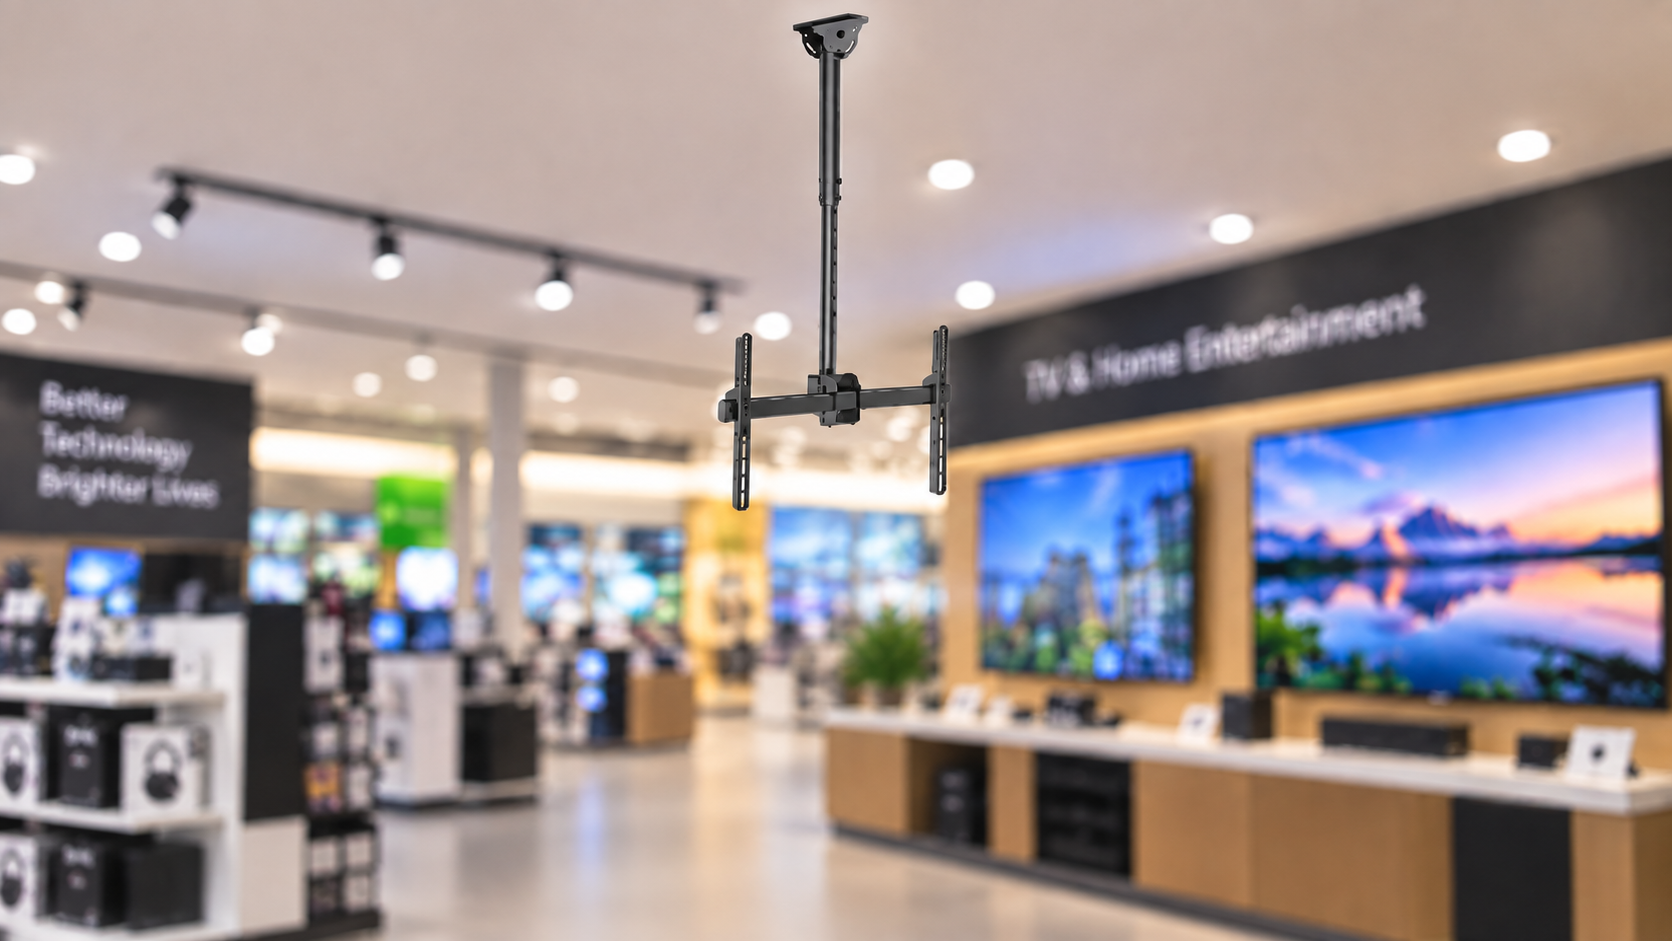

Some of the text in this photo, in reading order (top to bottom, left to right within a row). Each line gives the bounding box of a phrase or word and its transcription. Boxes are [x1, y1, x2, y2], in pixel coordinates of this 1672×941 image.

[1024, 284, 1426, 403] TV & Home Entertainment
[40, 380, 128, 422] Better
[39, 421, 192, 474] Technology
[38, 464, 220, 509] Brighter Lives
